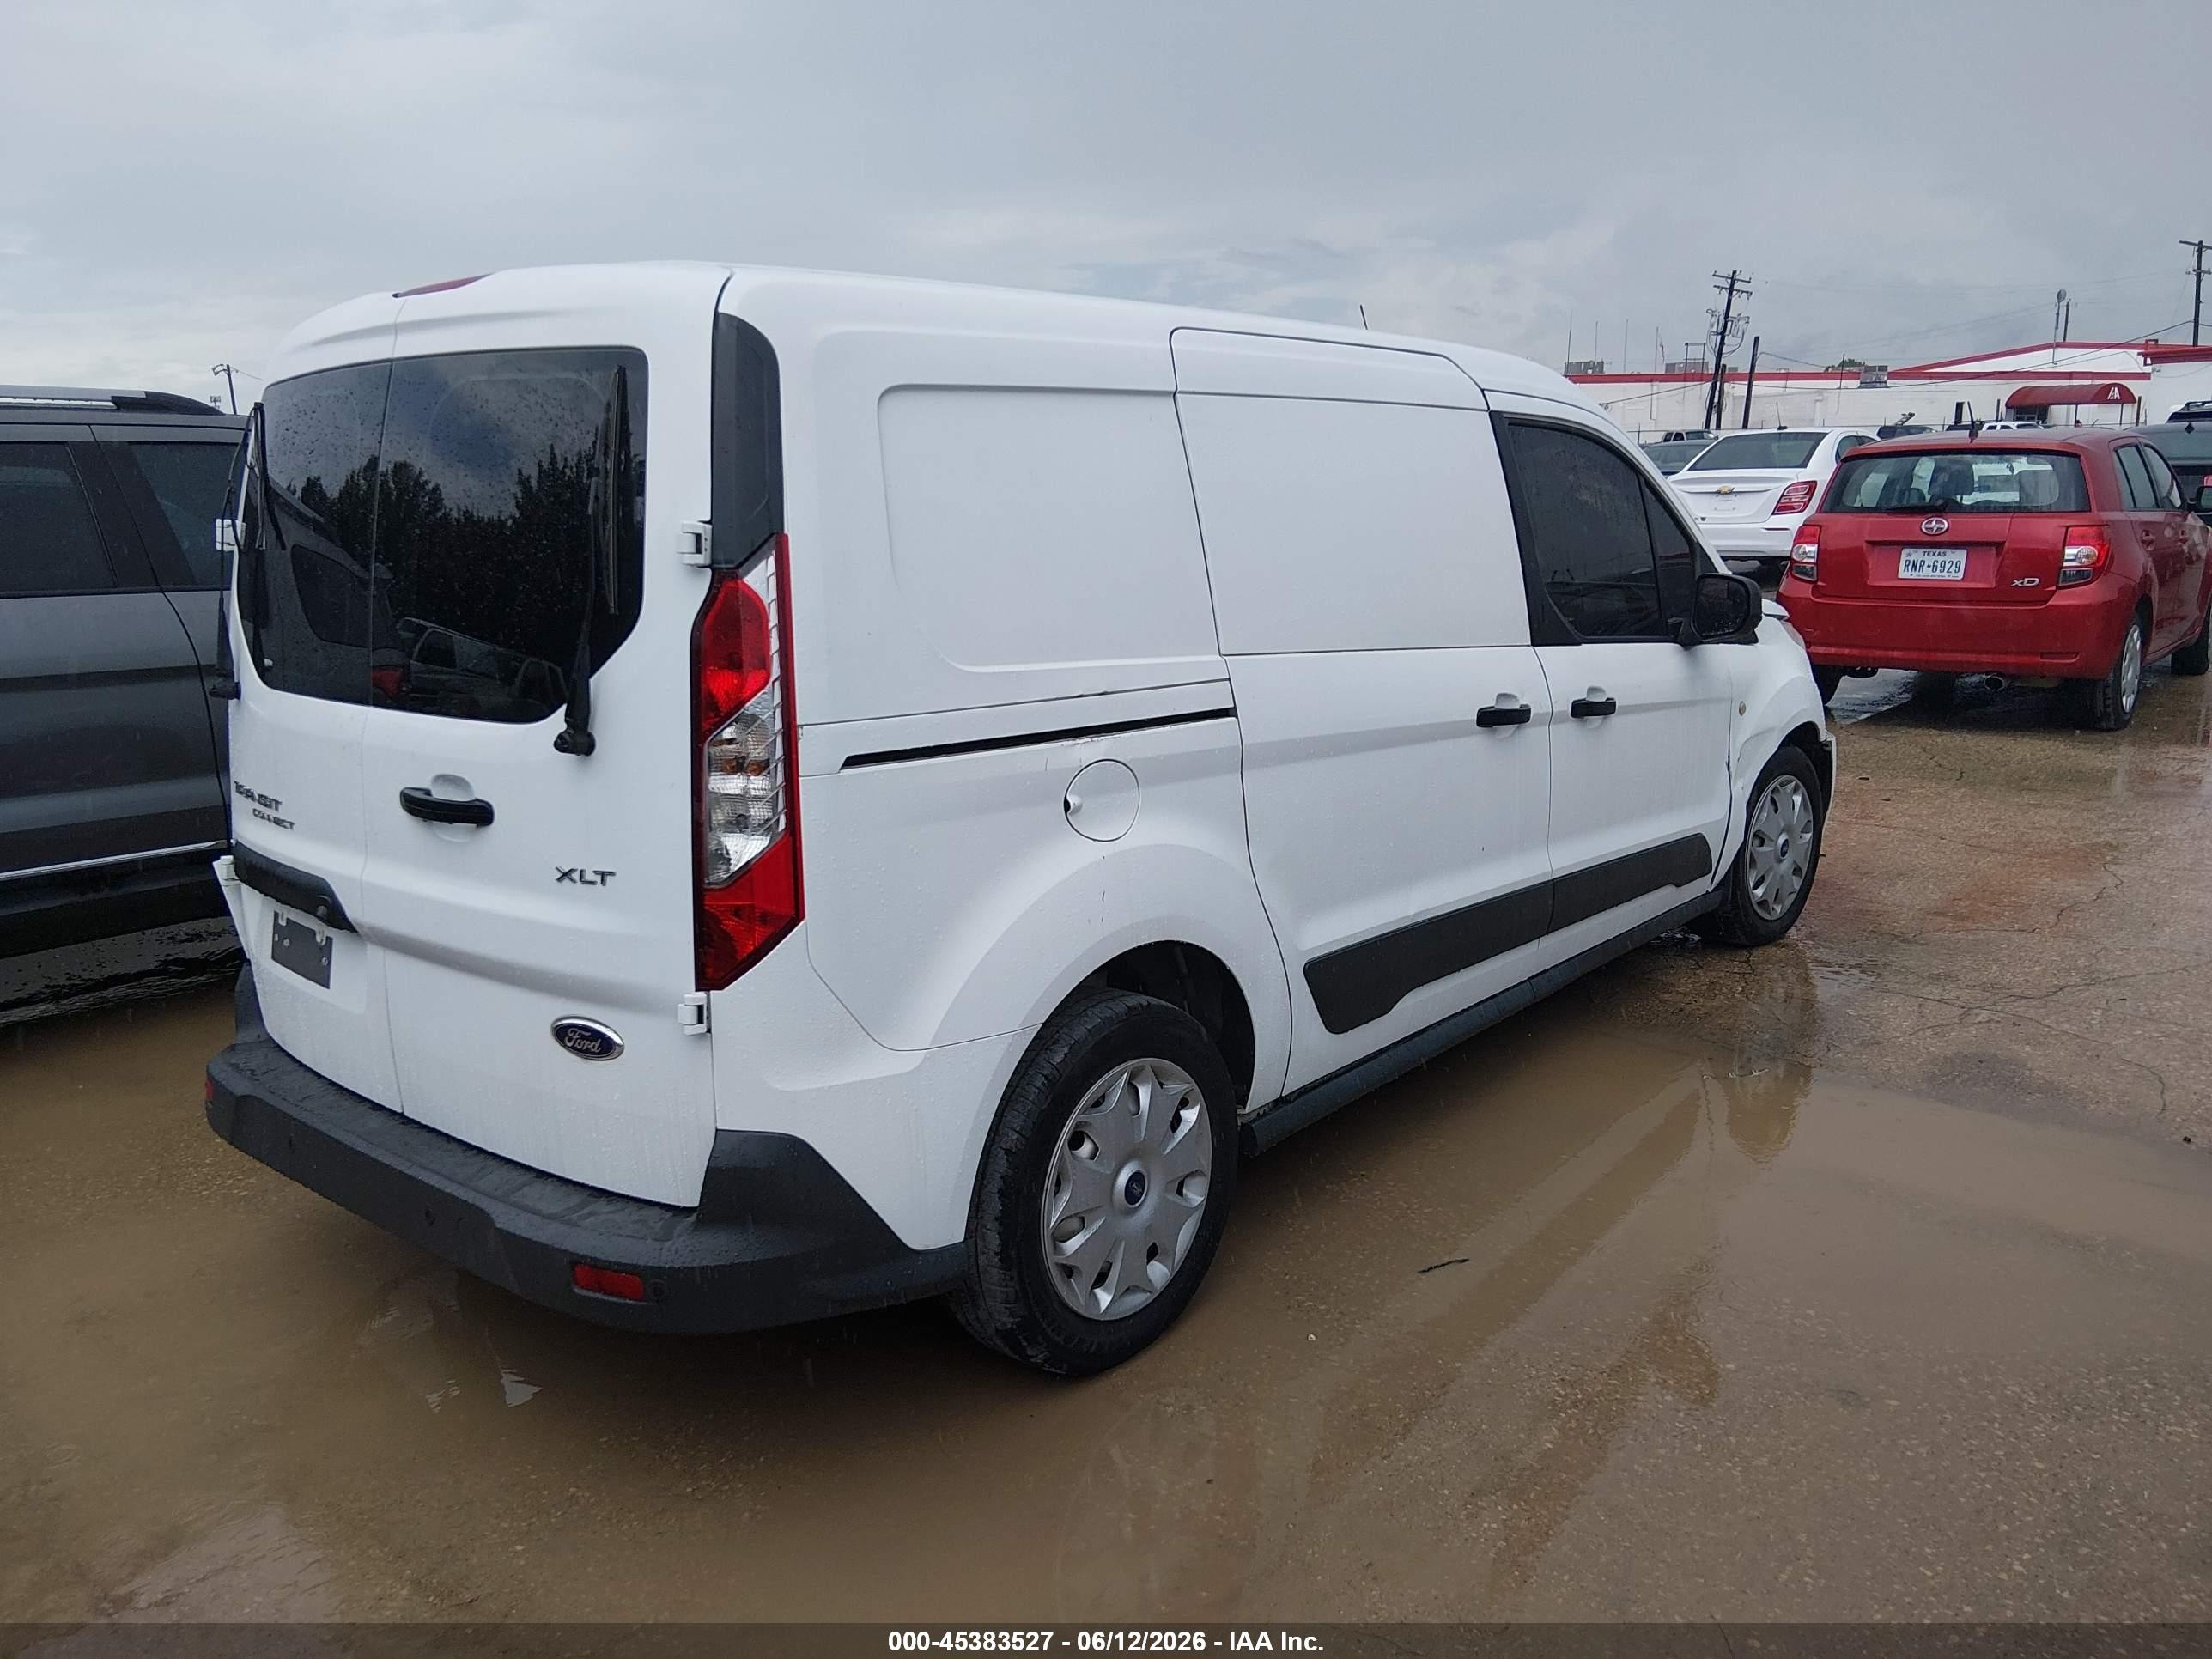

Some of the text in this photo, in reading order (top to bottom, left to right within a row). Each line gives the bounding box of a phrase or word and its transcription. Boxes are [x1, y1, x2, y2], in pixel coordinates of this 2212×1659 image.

[2010, 577, 2039, 586] xD
[555, 866, 617, 887] XLT
[564, 1028, 602, 1053] Ford
